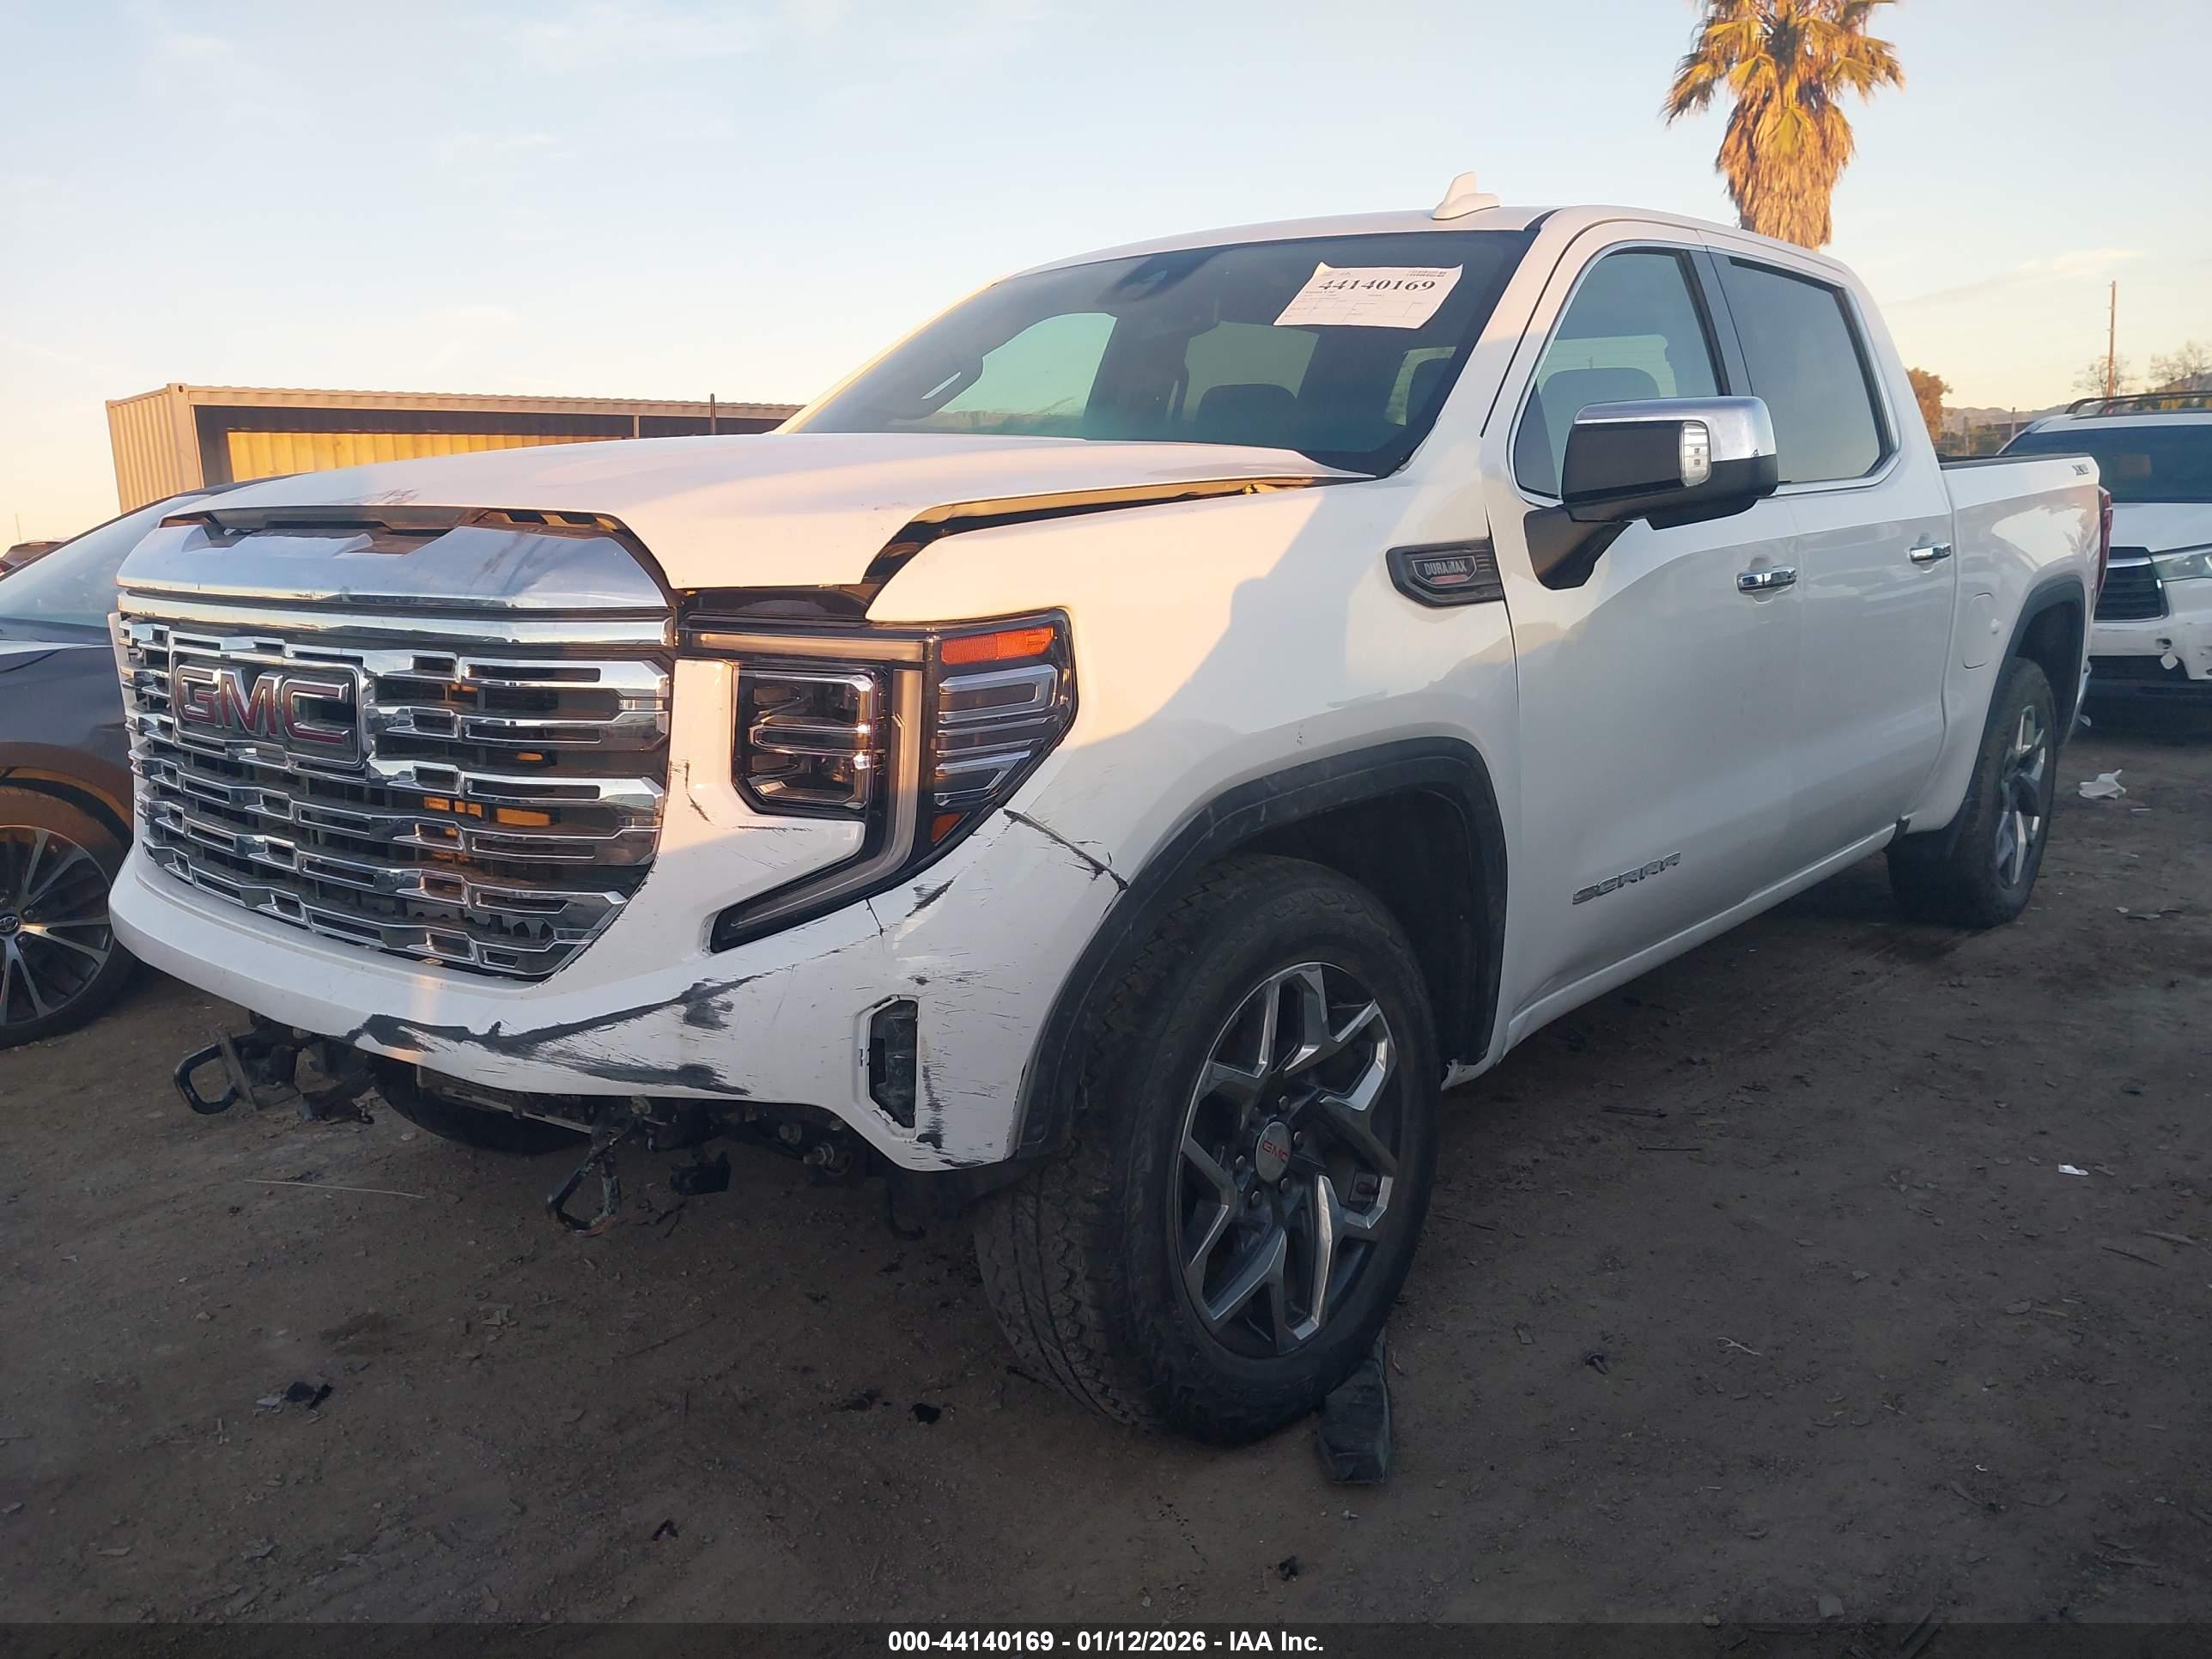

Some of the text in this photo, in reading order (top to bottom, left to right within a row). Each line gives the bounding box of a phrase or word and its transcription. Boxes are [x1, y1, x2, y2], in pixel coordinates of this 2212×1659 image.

[1317, 278, 1437, 292] 44140169
[1423, 559, 1468, 576] DURAMAX
[174, 664, 349, 745] GMC
[1261, 1139, 1289, 1164] GMC
